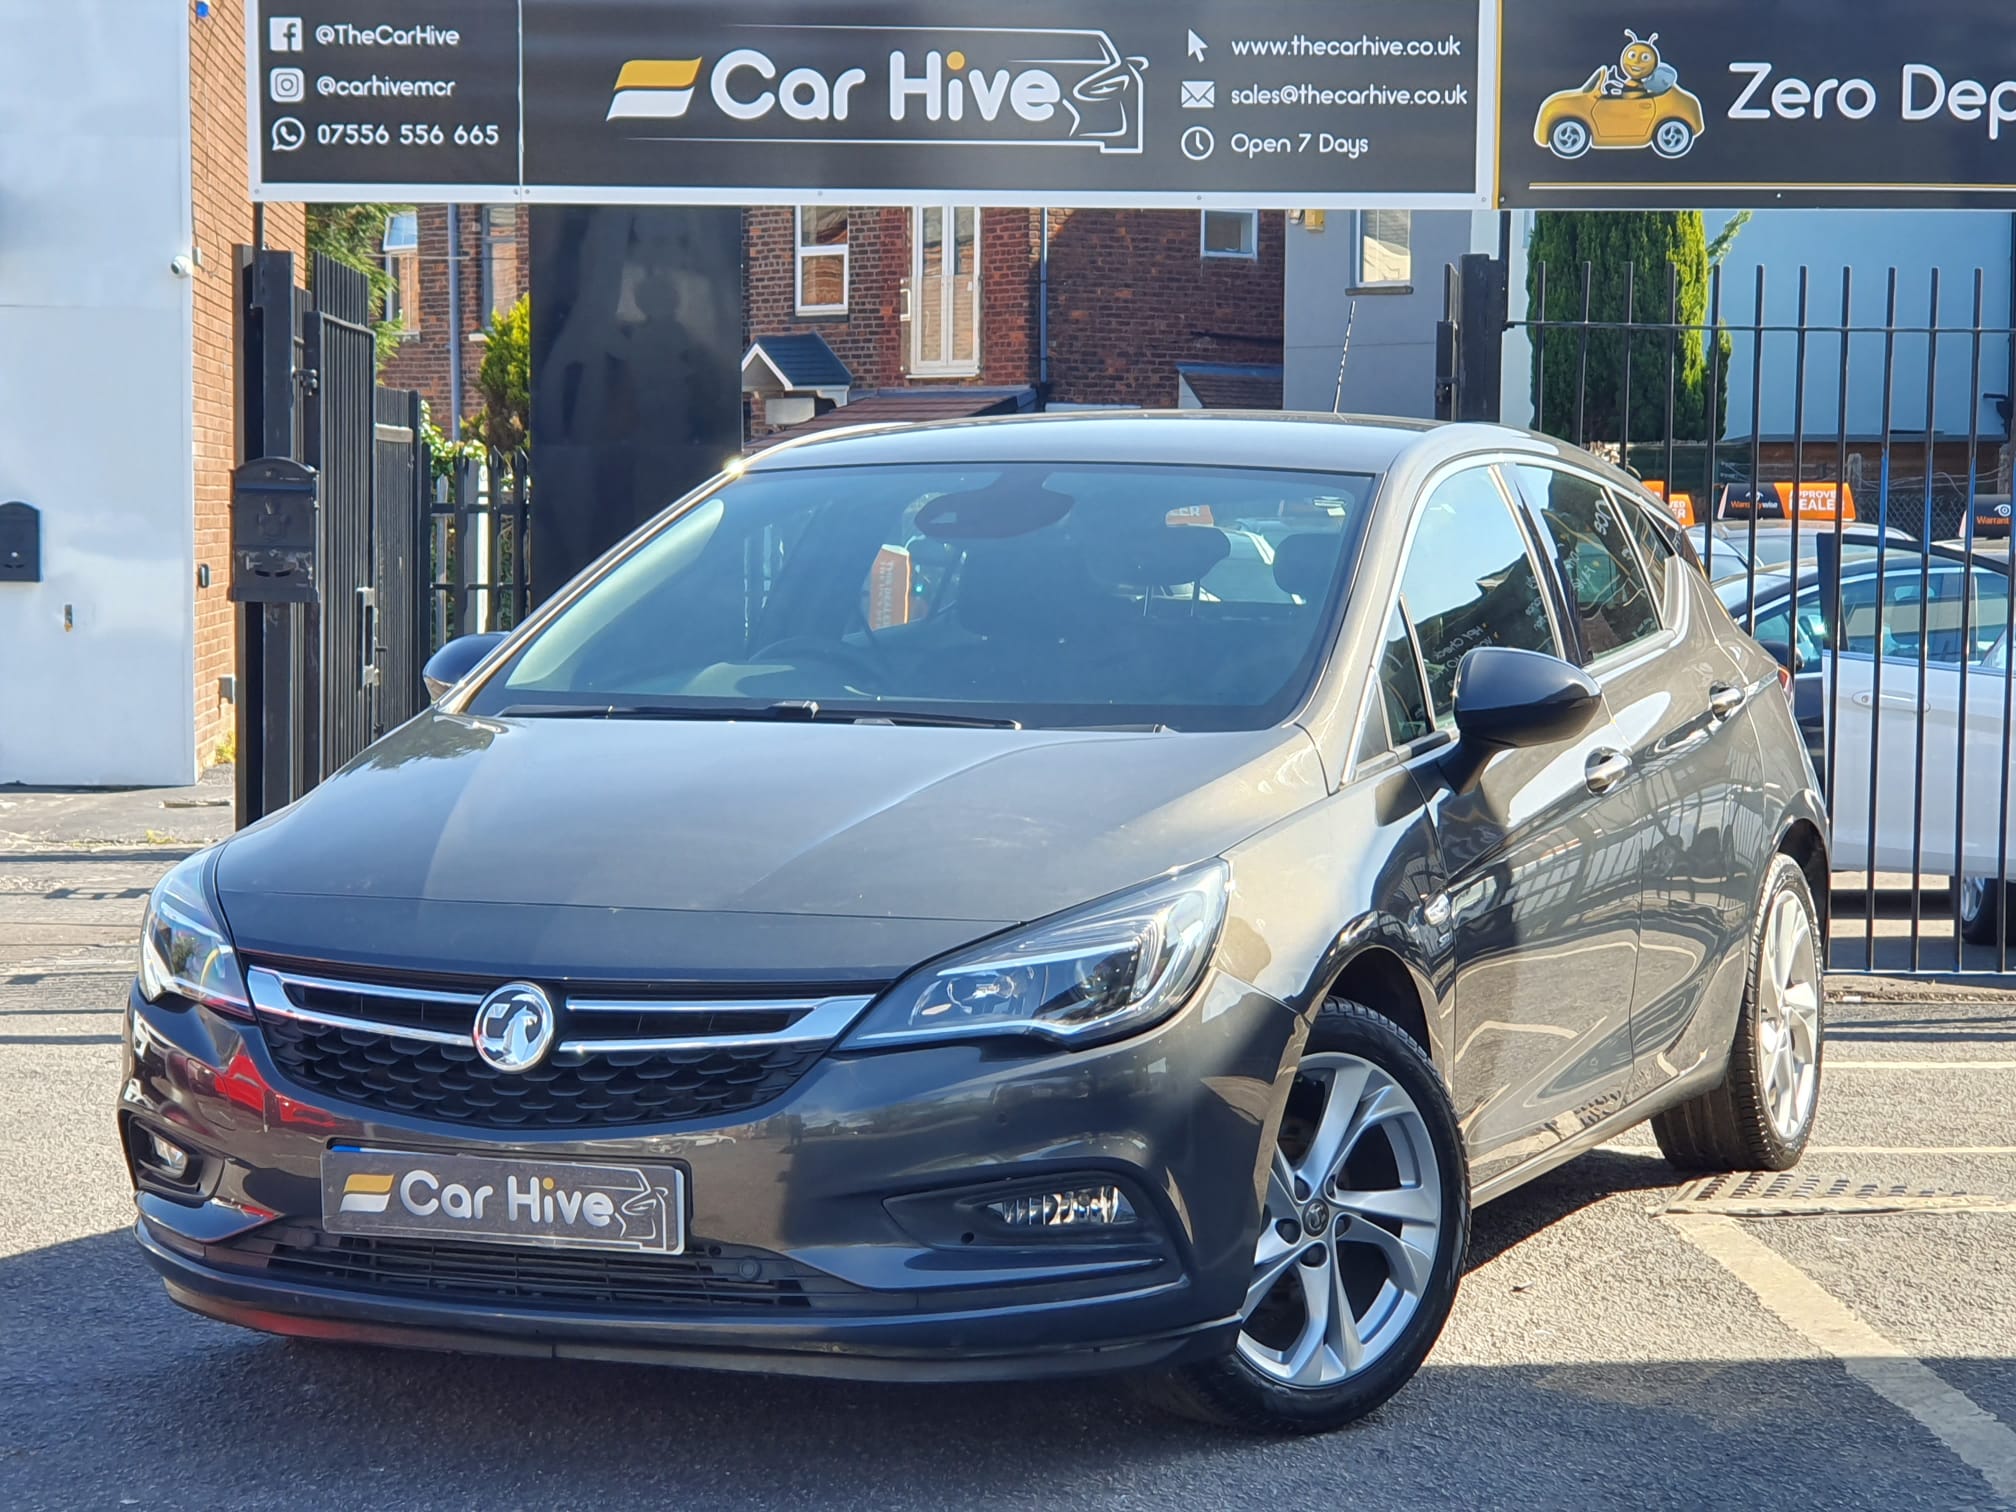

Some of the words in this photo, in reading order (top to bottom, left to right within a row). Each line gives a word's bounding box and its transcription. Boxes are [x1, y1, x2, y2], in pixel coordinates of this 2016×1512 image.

[315, 24, 460, 46] @TheCarHive
[1230, 34, 1462, 57] www.thecarhive.co.uk
[316, 75, 456, 97] @carhivemcr
[710, 48, 867, 121] Car
[889, 50, 1062, 123] Hive
[1230, 83, 1468, 105] sales@thecarhive.co.uk
[1727, 62, 1877, 120] Zero
[1901, 63, 2016, 141] Dep
[317, 124, 390, 145] 07556
[399, 124, 445, 145] 556
[453, 124, 499, 146] 665
[1230, 132, 1292, 160] Open
[1297, 132, 1313, 153] 7
[1318, 132, 1369, 160] Days
[399, 1169, 494, 1220] Car
[507, 1174, 615, 1228] Hive
